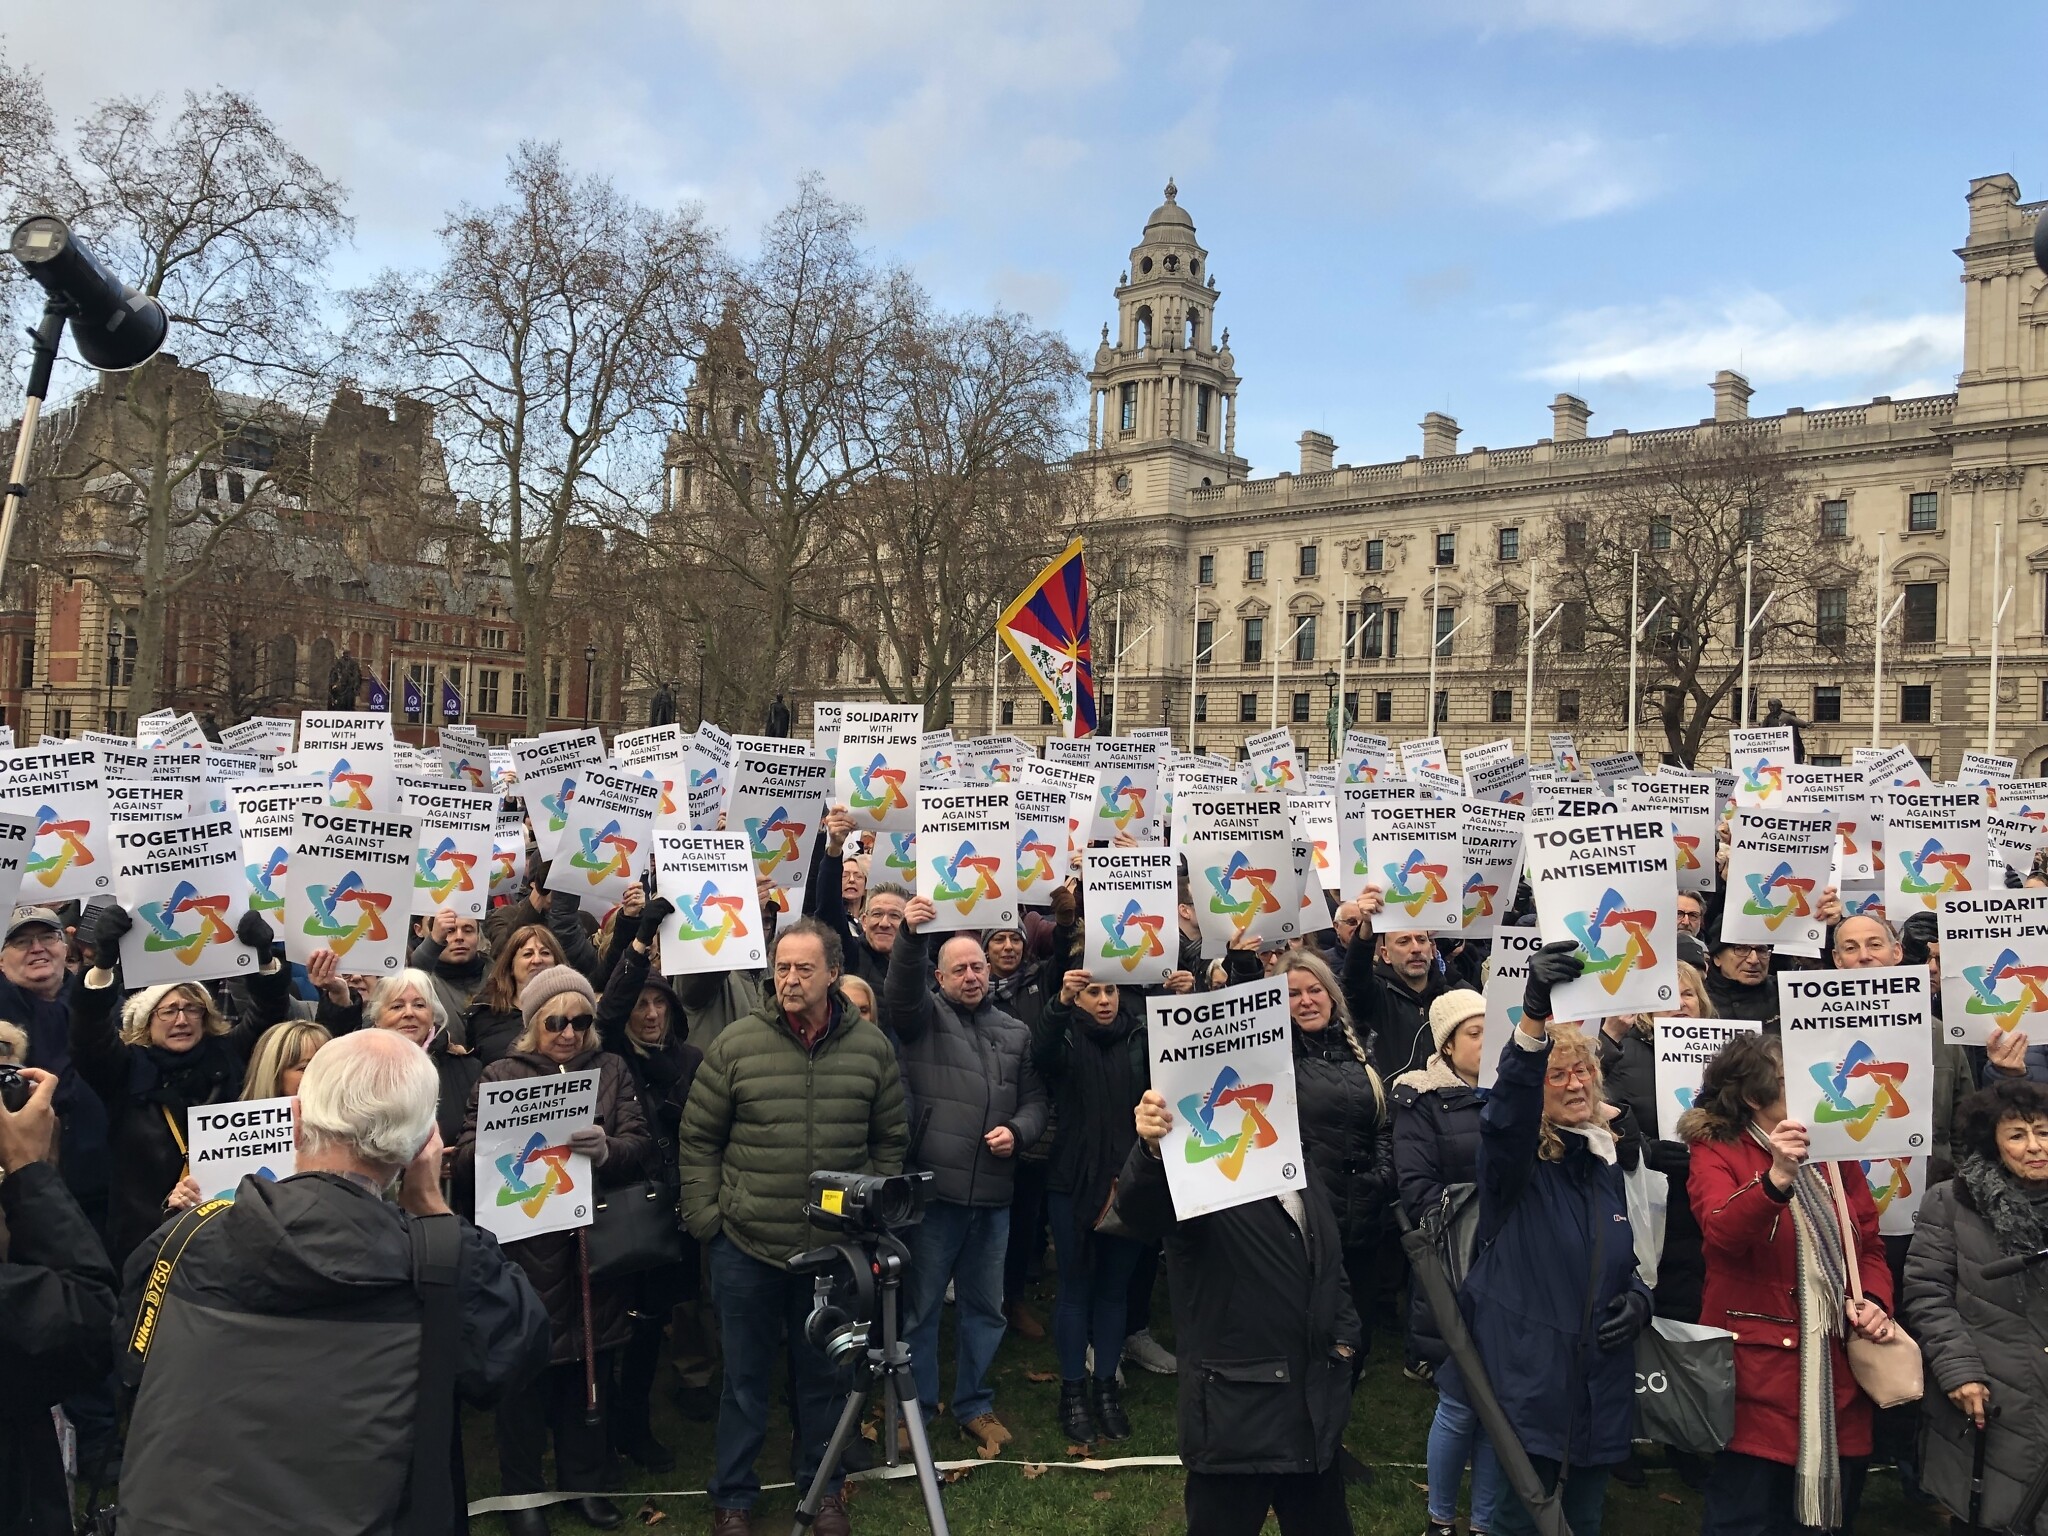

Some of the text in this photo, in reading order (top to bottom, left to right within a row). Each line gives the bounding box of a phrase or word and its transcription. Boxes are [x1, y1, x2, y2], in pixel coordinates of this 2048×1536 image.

[846, 712, 919, 723] SOLIDARITY
[161, 716, 193, 736] TOGETHER
[223, 721, 263, 740] TOGETHER
[306, 719, 385, 730] SOLIDARITY
[869, 725, 893, 733] WITH
[85, 735, 128, 747] TOGETHER
[166, 727, 199, 747] ANTISEMITISM
[229, 732, 268, 750] ANTISEMITISM
[442, 731, 487, 748] SOLIDARITY
[618, 731, 676, 750] TOGETHER
[843, 735, 917, 745] BRITISH JEWS
[973, 737, 1012, 747] TOGETHER
[1248, 731, 1286, 746] SOLIDARITY
[1349, 734, 1387, 747] TOGETHER
[1733, 731, 1789, 741] TOGETHER
[304, 741, 384, 751] BRITISH JEWS
[443, 743, 467, 755] BRITISH
[517, 735, 597, 762] TOGETHER
[630, 745, 661, 756] AGAINST
[714, 745, 729, 757] WITH
[736, 741, 805, 755] TOGETHER
[1050, 742, 1091, 752] TOGETH
[1096, 742, 1156, 753] TOGETHER
[1252, 742, 1290, 757] BRITISH JEWS
[1403, 740, 1440, 750] TOGETHER
[1464, 743, 1508, 760] SOLIDARITY
[1734, 746, 1790, 754] ANTISEMITISM
[540, 751, 580, 766] AGAINST
[622, 751, 678, 767] NTISEMITISM
[695, 743, 721, 763] BRITISH
[1346, 747, 1385, 758] ANTISEMITISM
[1405, 749, 1442, 759] ANTISEMITISM
[1480, 754, 1494, 762] WITH
[206, 758, 256, 770] TOGETHER
[1094, 761, 1155, 770] ANTISEMITISM
[1465, 761, 1491, 772] BRITISH
[1591, 755, 1634, 768] TOGETHER
[1604, 763, 1626, 771] AGAINST
[1879, 763, 1895, 773] WITH
[1895, 760, 1914, 774] JEWS
[1966, 755, 2013, 769] TOGETHER
[1976, 763, 2000, 771] AGAINST
[218, 769, 245, 777] AGAINST
[744, 760, 827, 778] TOGETHER
[1028, 763, 1095, 784] TOGETHER
[1473, 758, 1525, 782] TOGETHER
[1597, 765, 1639, 777] ANTISEMITISM
[1963, 767, 2011, 779] ANTISEMITISM
[9, 770, 69, 784] AGAINST
[762, 777, 806, 787] AGAINST
[1041, 777, 1078, 789] AGAINST
[1178, 773, 1238, 786] TOGETHER
[1420, 770, 1459, 786] TOGETHER
[1476, 771, 1527, 795] ANTISEMITISM
[1487, 771, 1515, 784] AGAINST
[1786, 773, 1863, 784] TOGETHER
[585, 771, 658, 799] TOGETHER
[739, 784, 821, 799] ANTISEMITISM
[1192, 784, 1223, 792] AGAINST
[1537, 787, 1592, 795] TOGETHER
[1632, 782, 1709, 795] TOGETHER
[1998, 782, 2048, 791] TOGETHER
[600, 789, 639, 804] AGAINST
[1016, 791, 1066, 804] GETHER
[1345, 788, 1415, 800] TOGETHER
[1649, 796, 1690, 804] AGAINST
[1786, 794, 1865, 803] ANTISEMITISM
[1888, 794, 1980, 806] TOGETHER
[2000, 794, 2048, 802] ANTISEMITISM
[409, 794, 493, 811] TOGETHER
[578, 795, 653, 819] ANTISEMITISM
[922, 795, 1009, 810] TOGETHER
[1192, 801, 1281, 816] TOGETHER
[1558, 800, 1618, 817] ZERO
[427, 809, 472, 820] AGAINST
[942, 811, 988, 819] AGAINST
[1371, 807, 1456, 820] TOGETHER
[1462, 803, 1526, 821] OGETHER
[1907, 809, 1956, 817] AGAINST
[256, 814, 294, 824] AGAINS
[1213, 818, 1259, 828] AGAINST
[1307, 816, 1333, 824] JEWS
[1470, 816, 1508, 828] AGAINST
[1740, 814, 1832, 832] TOGETHER
[1889, 819, 1981, 830] ANTISEMITISM
[302, 813, 413, 839] TOGETHER
[922, 821, 1010, 833] ANTISEMITISM
[1391, 822, 1436, 830] AGAINST
[116, 821, 232, 848] TOGETHER
[325, 834, 385, 848] AGAINST
[1193, 830, 1284, 841] ANTISEMITISM
[1372, 832, 1457, 841] ANTISEMITISM
[1534, 821, 1664, 849] TOGETHER
[1761, 832, 1811, 843] AGAINST
[659, 838, 744, 850] TOGETHER
[1462, 836, 1517, 848] LIDARITY
[1737, 840, 1829, 854] ANTISEMITISM
[2000, 838, 2032, 851] JEWS
[147, 843, 208, 859] AGAINST
[297, 844, 410, 866] ANTISEMITISM
[682, 853, 726, 861] AGAINST
[1468, 848, 1491, 856] WITH
[1569, 844, 1636, 861] AGAINST
[120, 851, 237, 877] ANTISEMITISM
[662, 863, 748, 872] ANTISEMITISM
[1088, 855, 1171, 868] TOGETHER
[1109, 870, 1152, 878] AGAINST
[1540, 858, 1668, 882] ANTISEMITISM
[1089, 880, 1172, 891] ANTISEMITISM
[1945, 897, 2048, 914] SOLIDARIT
[1985, 914, 2022, 925] WITH
[1946, 927, 2011, 940] BRITISH
[1788, 977, 1921, 998] TOGETHER
[1157, 988, 1282, 1026] TOGETHER
[1821, 999, 1890, 1012] AGAINST
[1790, 1013, 1922, 1030] ANTISEMITISM
[1191, 1017, 1256, 1041] AGAINST
[1159, 1027, 1284, 1063] ANTISEMITISM
[487, 1079, 592, 1105] TOGETHER
[511, 1098, 567, 1115] AGAINST
[197, 1107, 292, 1131] TOGETH
[484, 1105, 588, 1131] ANTISEMITISM
[228, 1127, 293, 1142] AGAINST
[198, 1141, 293, 1162] ANTISEMIT
[134, 1260, 171, 1352] Nikon D750
